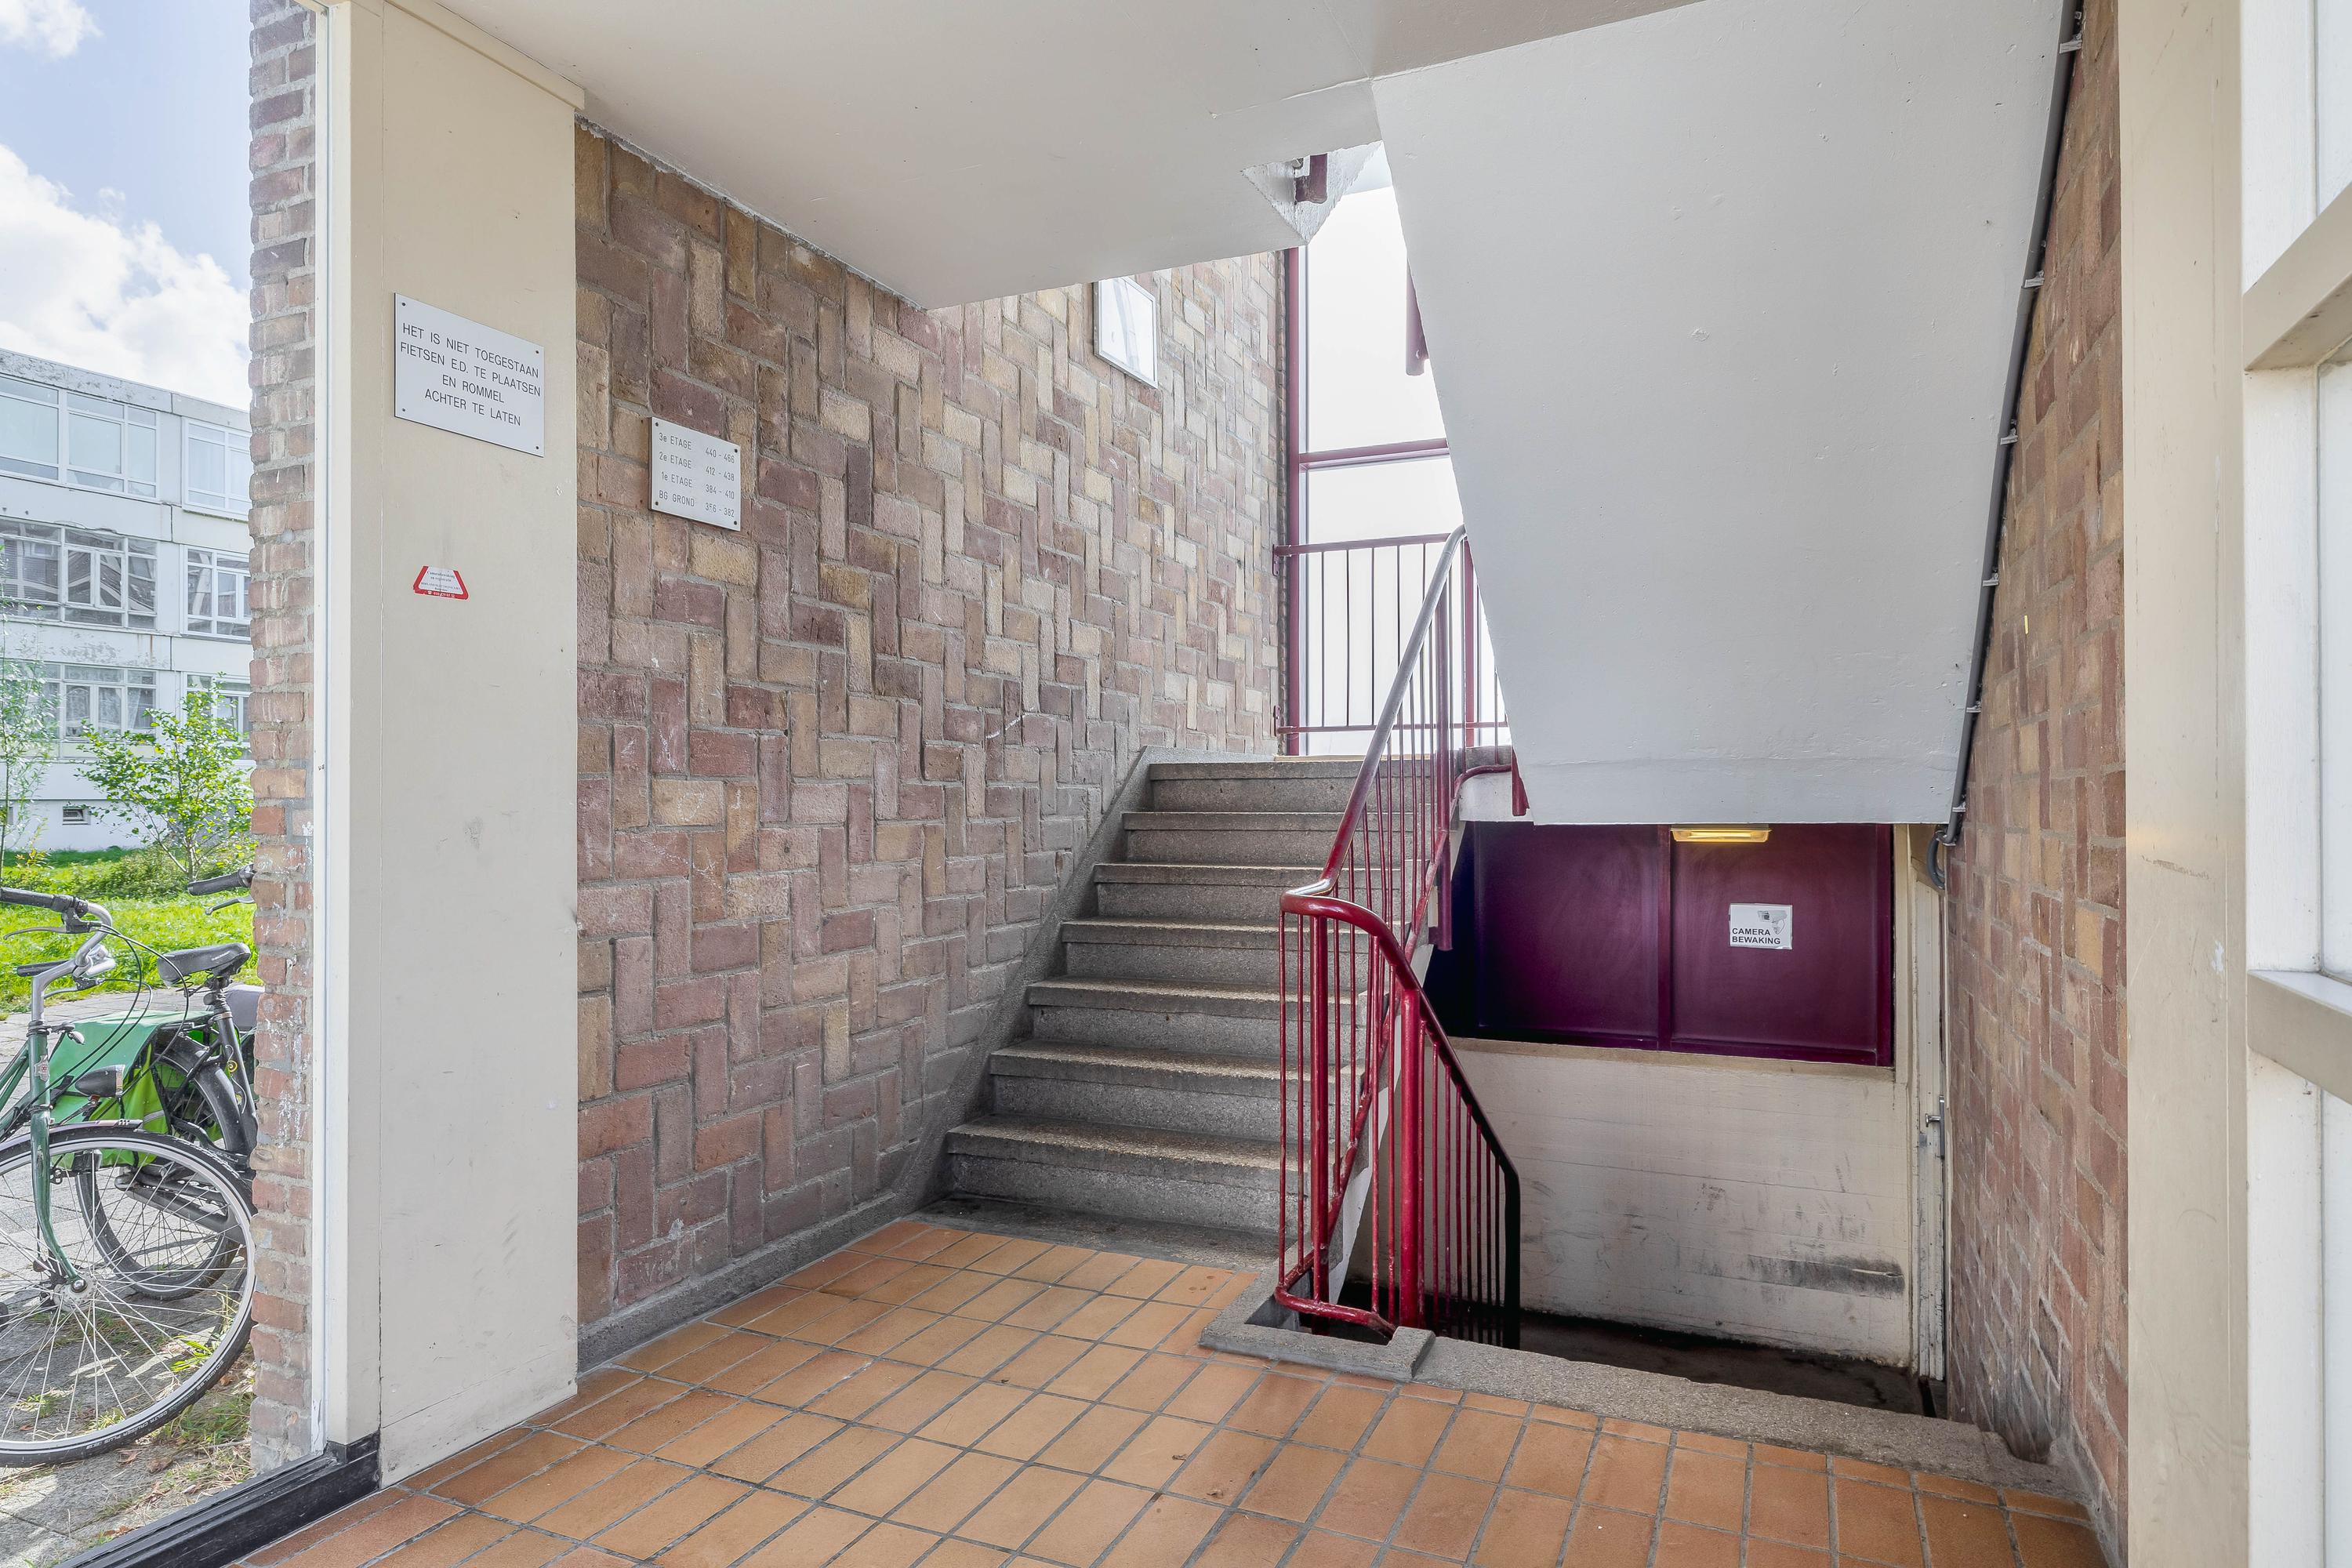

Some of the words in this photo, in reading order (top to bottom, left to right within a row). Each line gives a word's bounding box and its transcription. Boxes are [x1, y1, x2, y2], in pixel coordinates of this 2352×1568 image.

[403, 323, 424, 339] HET
[430, 332, 441, 345] IS
[446, 337, 469, 354] NIET
[475, 347, 539, 378] TOEGESTAAN
[401, 342, 445, 365] FIETSEN
[451, 358, 469, 373] E.D.
[474, 365, 486, 379] TE
[492, 372, 540, 397] PLAATSEN
[442, 375, 456, 388] EN
[462, 381, 504, 403] ROMMEL
[425, 389, 466, 409] ACHTER
[472, 402, 485, 416] TE
[490, 408, 521, 426] LATEN
[659, 433, 667, 442] 3e
[670, 436, 691, 450] ETAGE
[706, 448, 717, 458] 440
[724, 454, 735, 463] 466
[659, 452, 667, 461] 2e
[670, 455, 691, 469] ETAGE
[706, 466, 715, 476] 412
[724, 473, 735, 481] 438
[662, 471, 668, 481] 1e
[671, 474, 692, 488] ETAGE
[706, 485, 717, 494] 384
[725, 491, 735, 499] 410
[659, 490, 668, 500] BG
[672, 494, 695, 507] GROND
[724, 508, 735, 517] 382
[1732, 936, 1780, 945] BEWAKING
